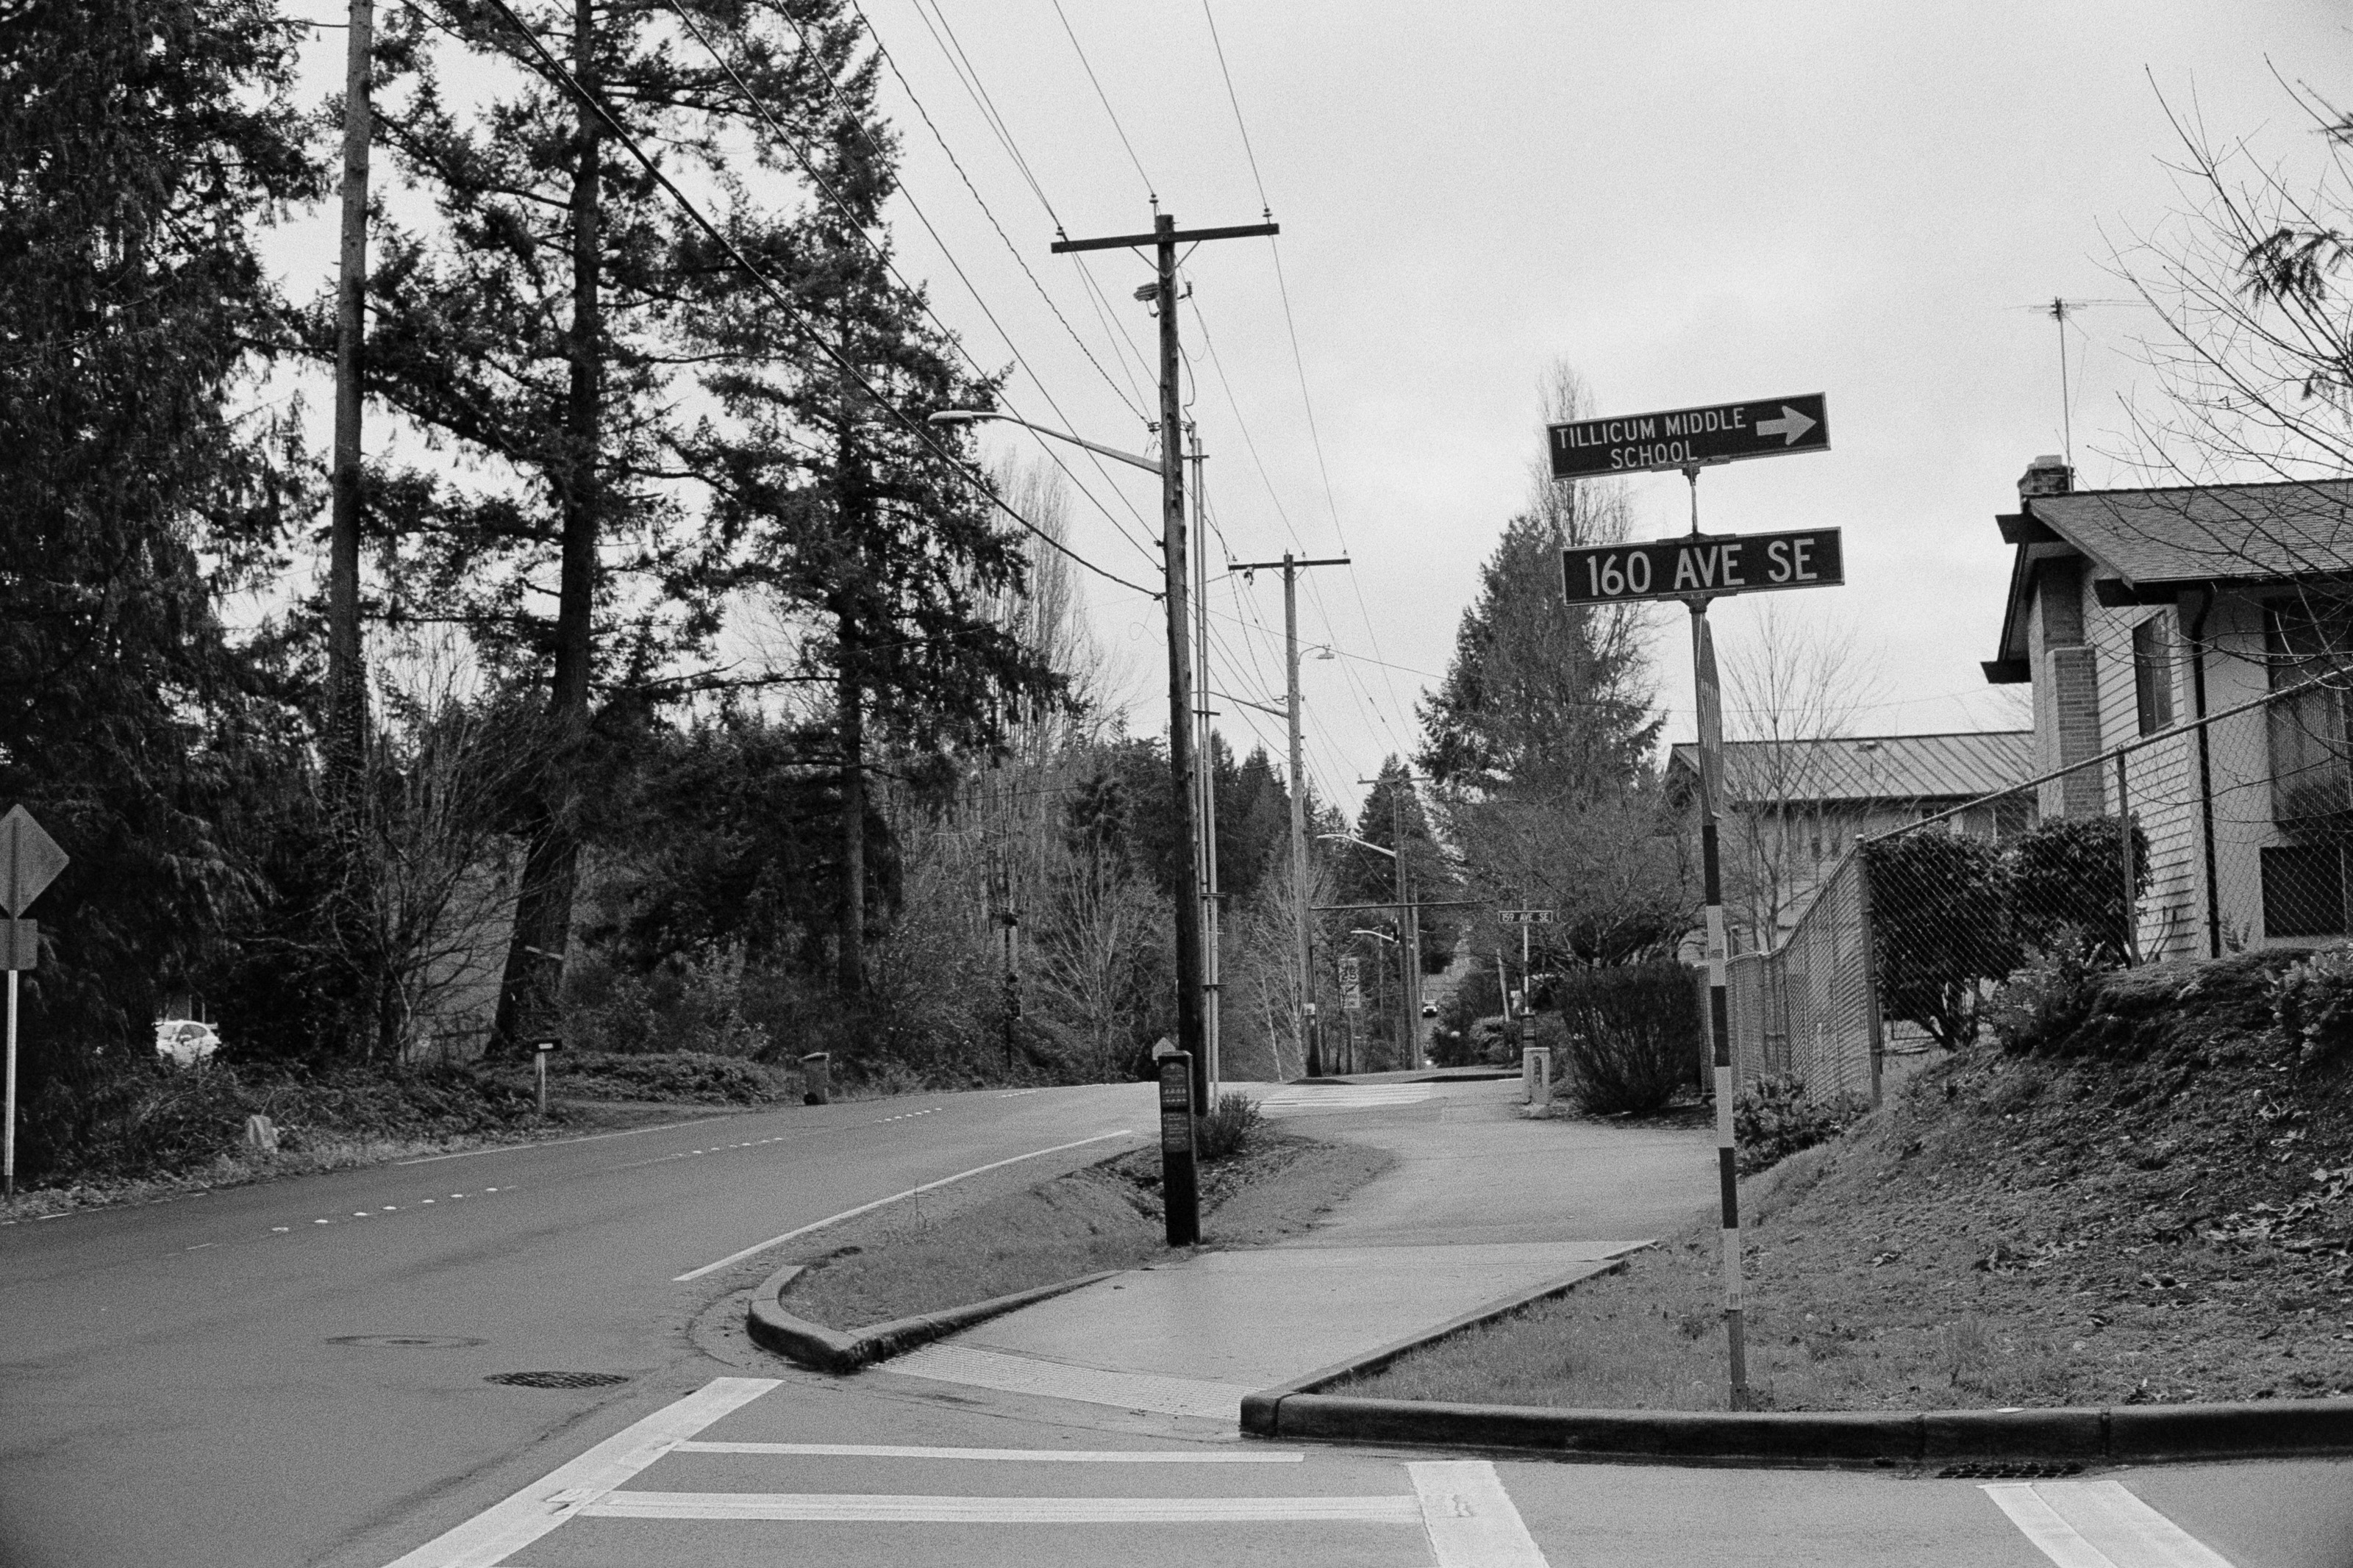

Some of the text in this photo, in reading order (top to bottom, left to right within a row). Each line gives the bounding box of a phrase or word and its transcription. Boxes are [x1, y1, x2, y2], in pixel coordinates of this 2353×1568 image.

[1557, 407, 1746, 449] TILLICUM MIDDLE
[1610, 440, 1699, 470] SCHOOL
[1586, 538, 1818, 597] 160 AVE SE
[1519, 912, 1534, 923] AVE
[1539, 912, 1549, 922] SE
